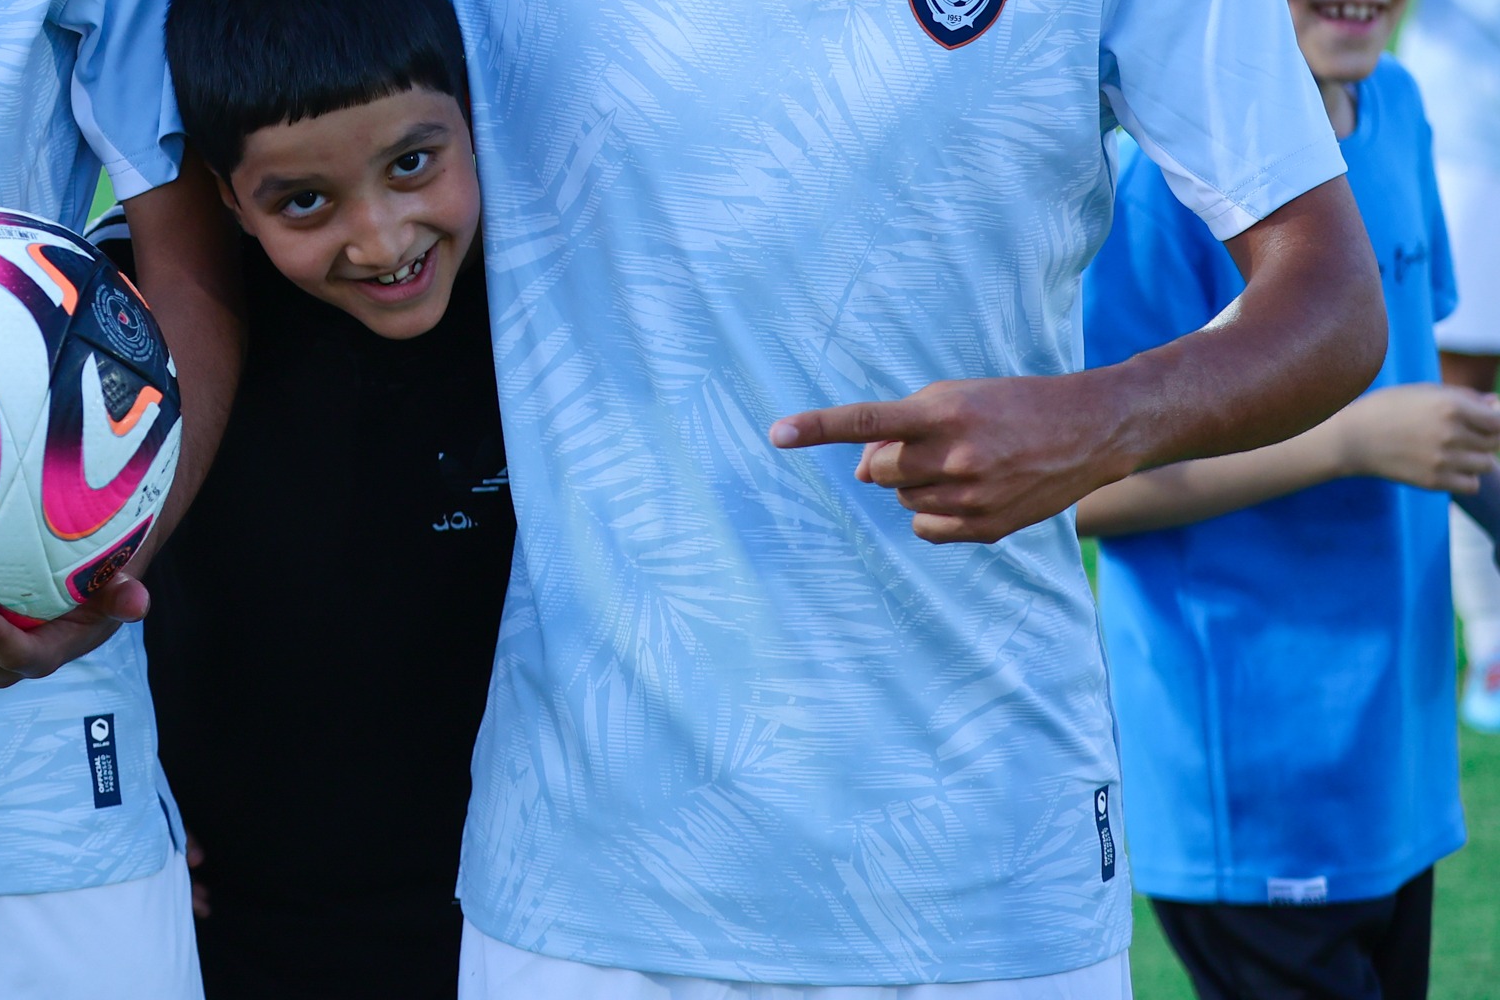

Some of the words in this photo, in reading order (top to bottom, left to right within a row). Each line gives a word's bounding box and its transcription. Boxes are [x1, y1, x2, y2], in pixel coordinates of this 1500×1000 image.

[947, 14, 962, 22] 1953
[94, 755, 104, 794] OFFICIAL
[101, 754, 110, 792] LICENSED
[106, 754, 114, 792] PRODUCT
